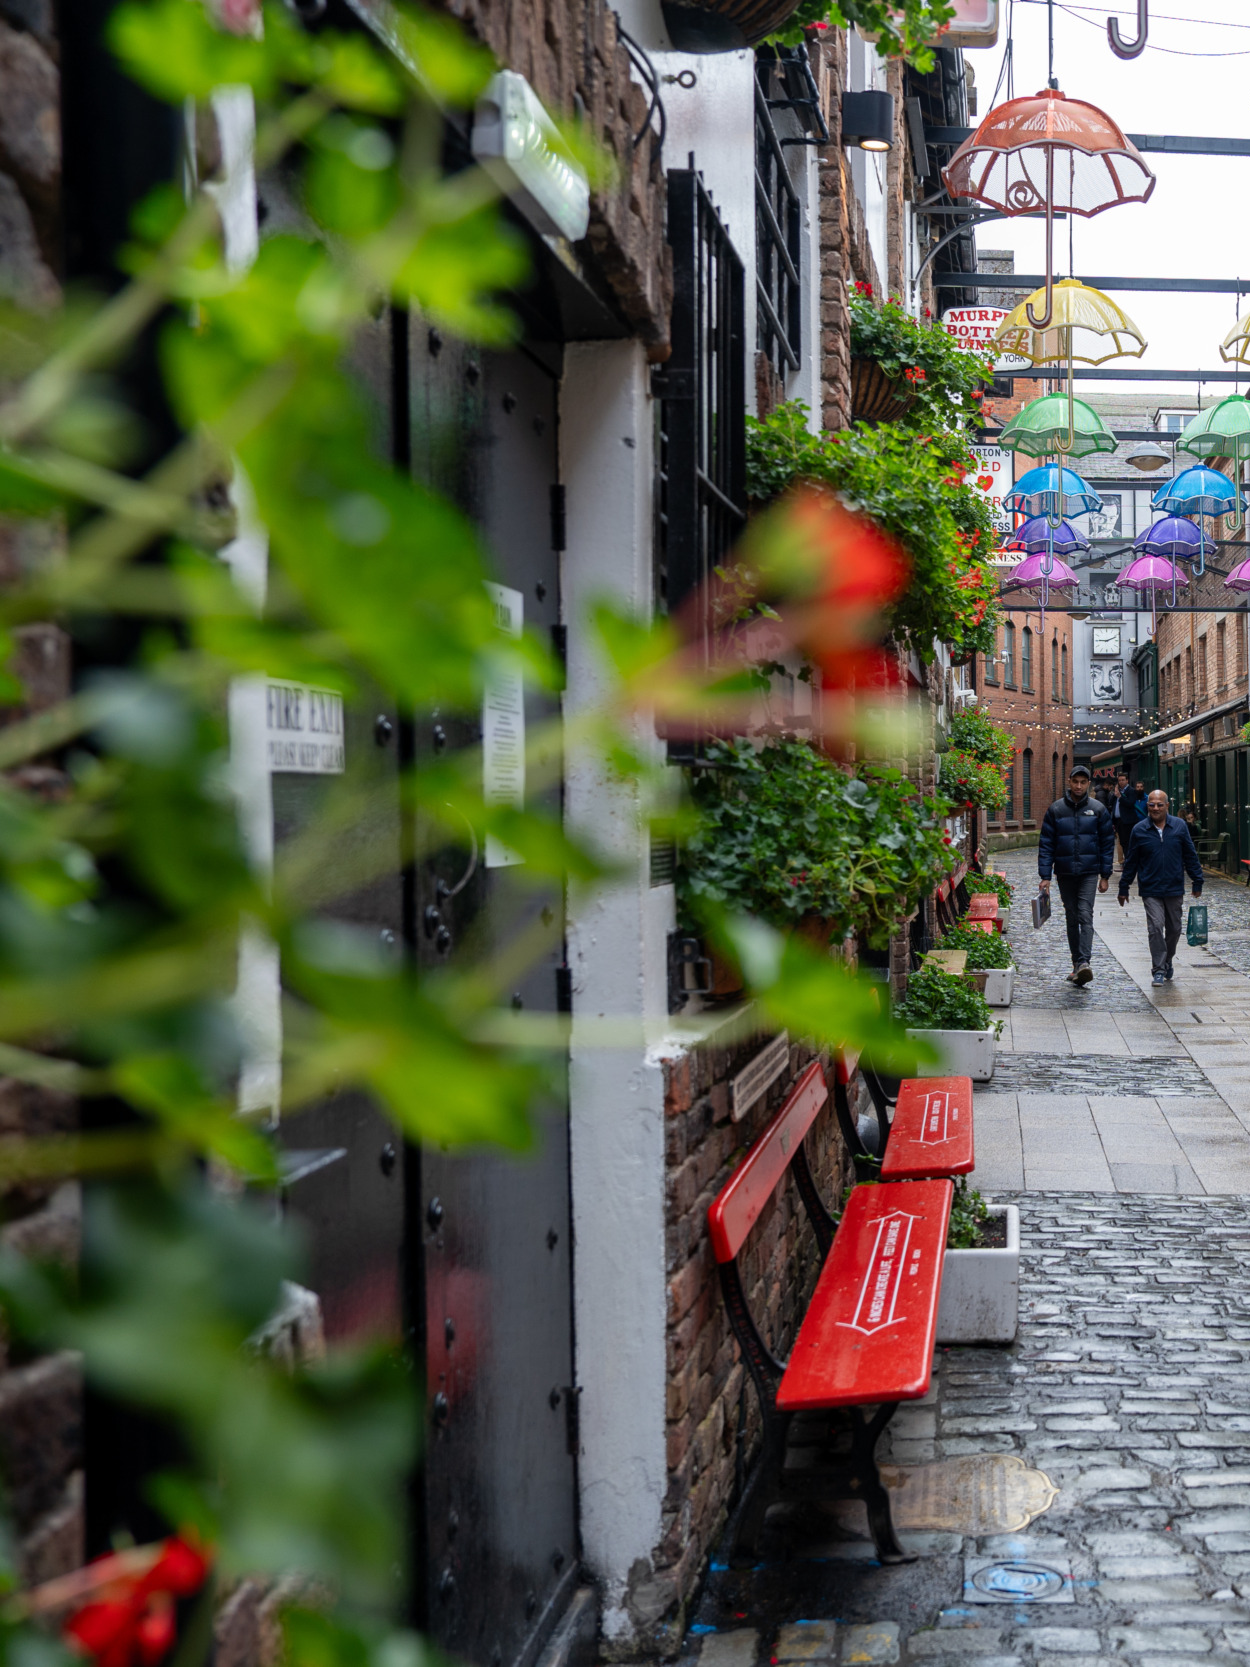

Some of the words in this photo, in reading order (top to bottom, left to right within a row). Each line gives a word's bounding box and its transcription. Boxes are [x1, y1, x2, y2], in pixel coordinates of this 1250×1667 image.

[946, 323, 1030, 340] BOTTED
[1003, 353, 1026, 363] YORK
[968, 448, 1010, 457] ORTON'S
[974, 461, 1002, 472] ED
[267, 683, 305, 732] FIRE
[309, 690, 342, 736] EXIT
[1093, 767, 1115, 778] AR
